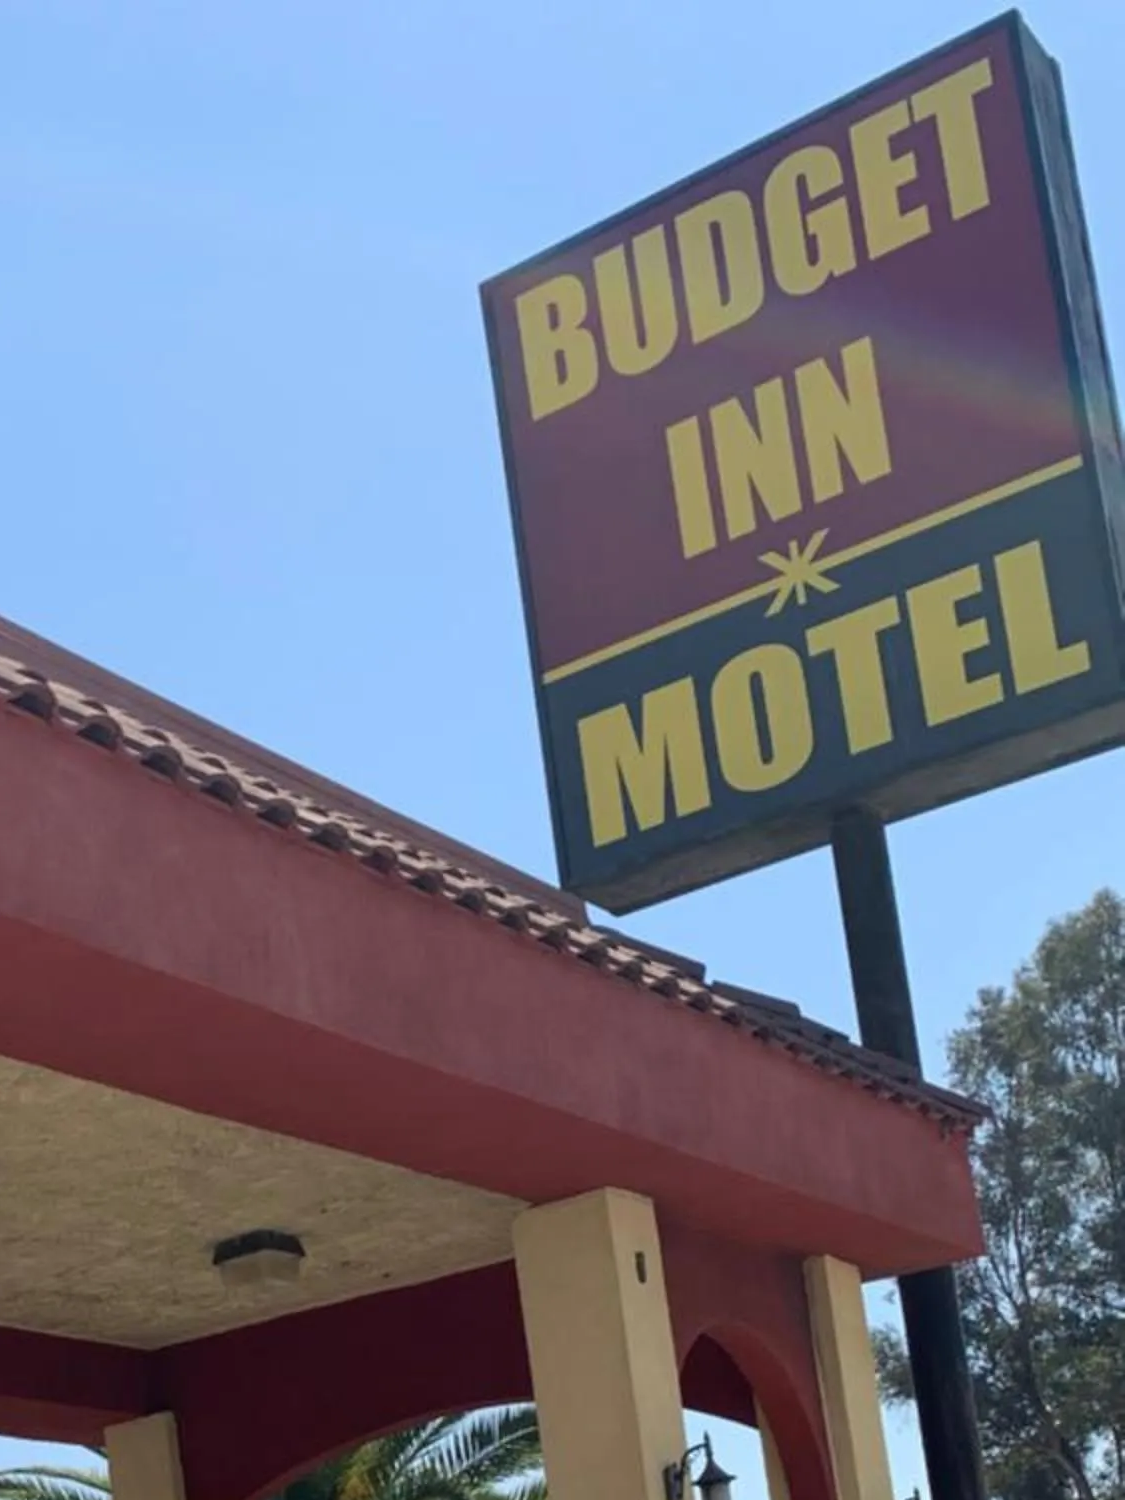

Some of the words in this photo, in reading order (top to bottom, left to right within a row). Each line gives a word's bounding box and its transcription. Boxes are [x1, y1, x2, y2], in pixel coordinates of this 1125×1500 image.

[515, 57, 994, 422] BUDGET
[666, 336, 893, 561] INN
[577, 540, 1092, 849] MOTEL
